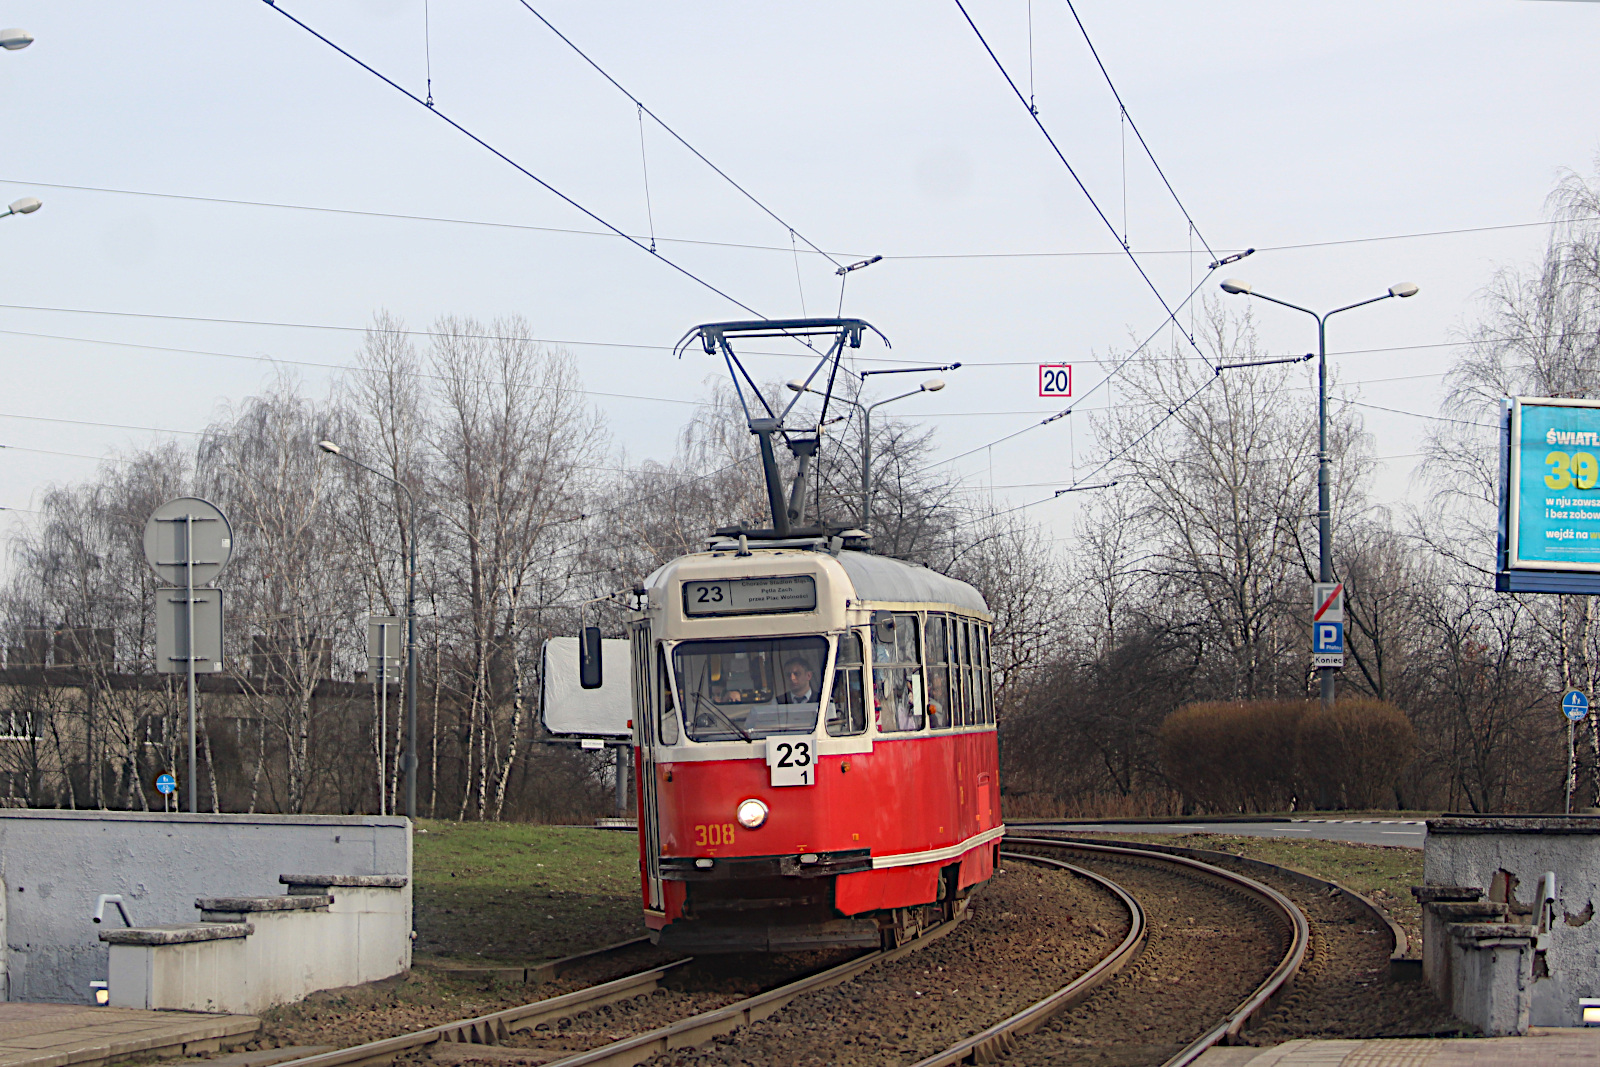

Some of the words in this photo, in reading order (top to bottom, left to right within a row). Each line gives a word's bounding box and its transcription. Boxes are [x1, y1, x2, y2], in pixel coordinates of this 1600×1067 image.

[1044, 370, 1068, 392] 20
[1544, 451, 1599, 489] 39
[1556, 496, 1571, 508] nju
[1546, 508, 1549, 518] i
[1550, 509, 1568, 519] bez
[1546, 529, 1574, 541] wejdź
[697, 586, 724, 603] 23
[1319, 625, 1337, 649] P
[1315, 656, 1342, 664] Koniec
[776, 742, 811, 768] 23
[800, 770, 808, 785] 1
[695, 824, 735, 846] 308
